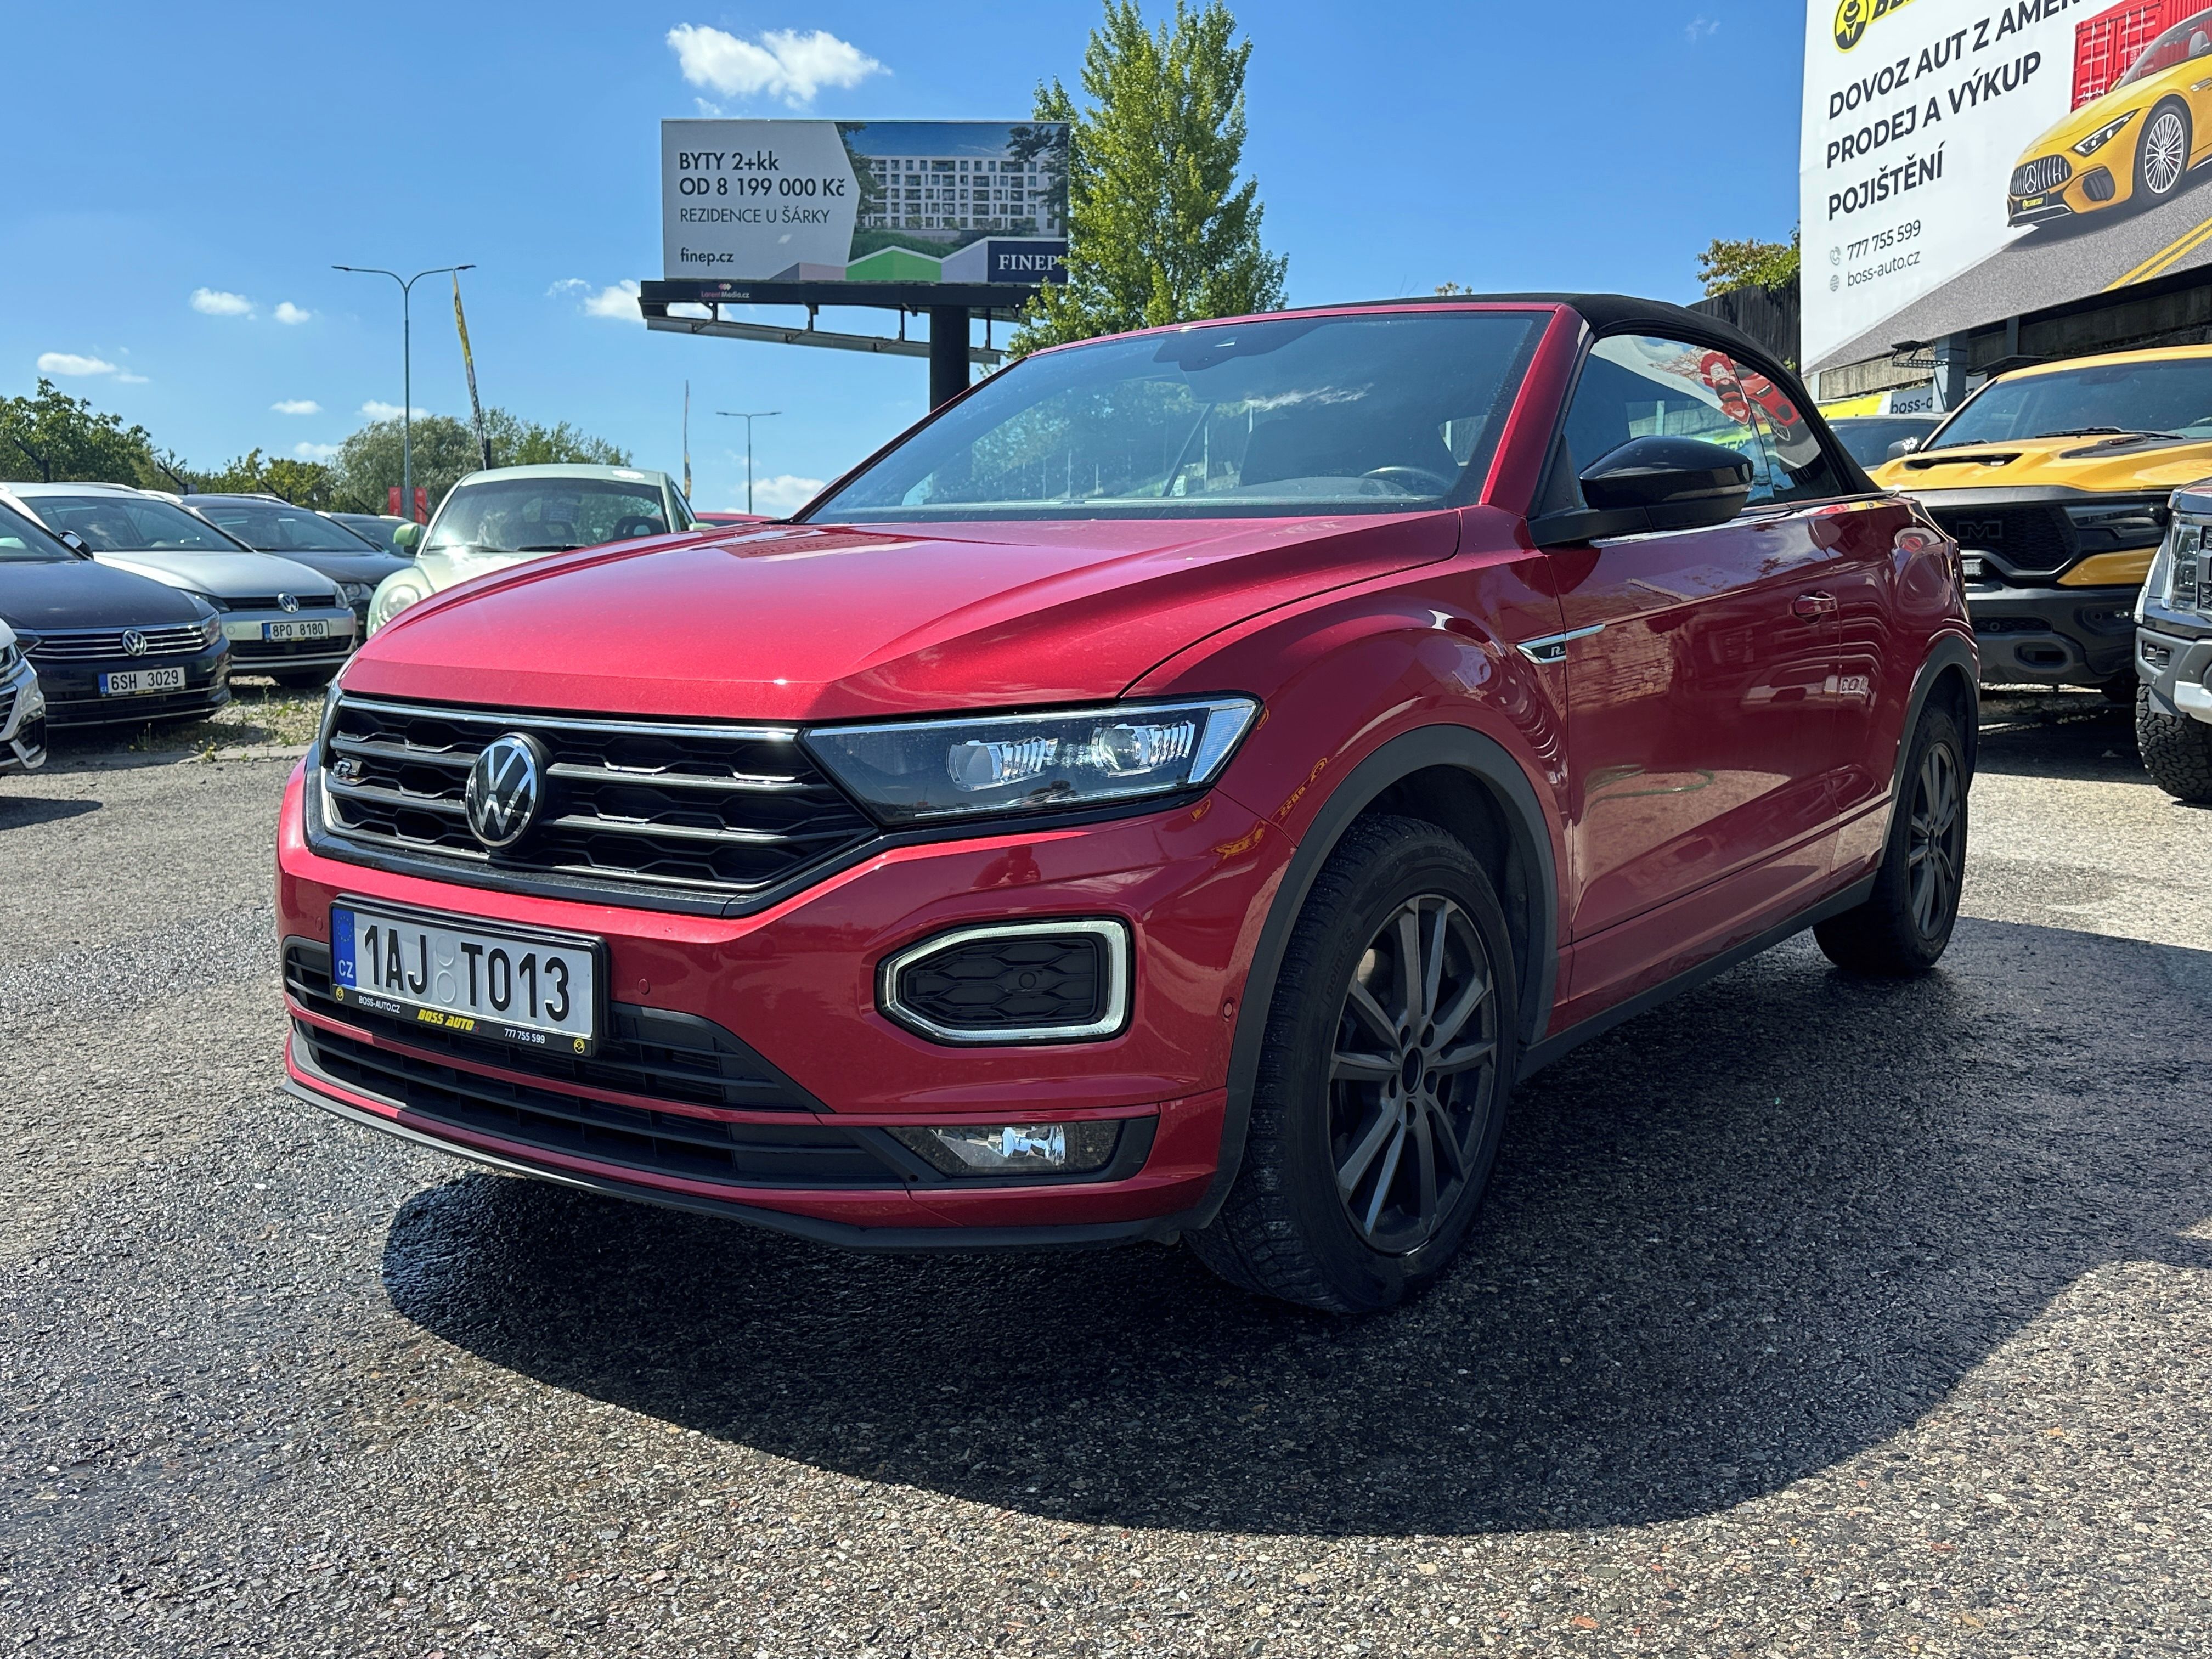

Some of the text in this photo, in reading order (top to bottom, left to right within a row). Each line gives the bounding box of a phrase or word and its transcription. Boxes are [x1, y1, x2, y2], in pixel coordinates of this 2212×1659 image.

[1829, 0, 2080, 120] DOVOZ AUT Z AME
[1827, 51, 2041, 169] PRODEJ A VÝKUP
[679, 150, 779, 171] BYTY 2+kk
[679, 177, 845, 197] OD 8 199 000 Kč
[1829, 140, 1946, 221] POJIŠTĚNÍ
[680, 205, 831, 224] REZIDENCE U ŠÁRKY
[1847, 219, 1921, 261] 777 755 599
[680, 247, 734, 267] finep.cz
[998, 254, 1059, 271] FINEP
[1847, 251, 1921, 287] boss-auto.cz
[300, 623, 323, 636] 8180
[111, 670, 178, 690] 6SH 3029
[338, 959, 354, 979] CZ
[365, 924, 428, 995] 1AJ
[358, 995, 400, 1013] BOSS-AUTO.CZ
[417, 1009, 444, 1024] BOSS
[504, 1028, 545, 1045] 777 755 599
